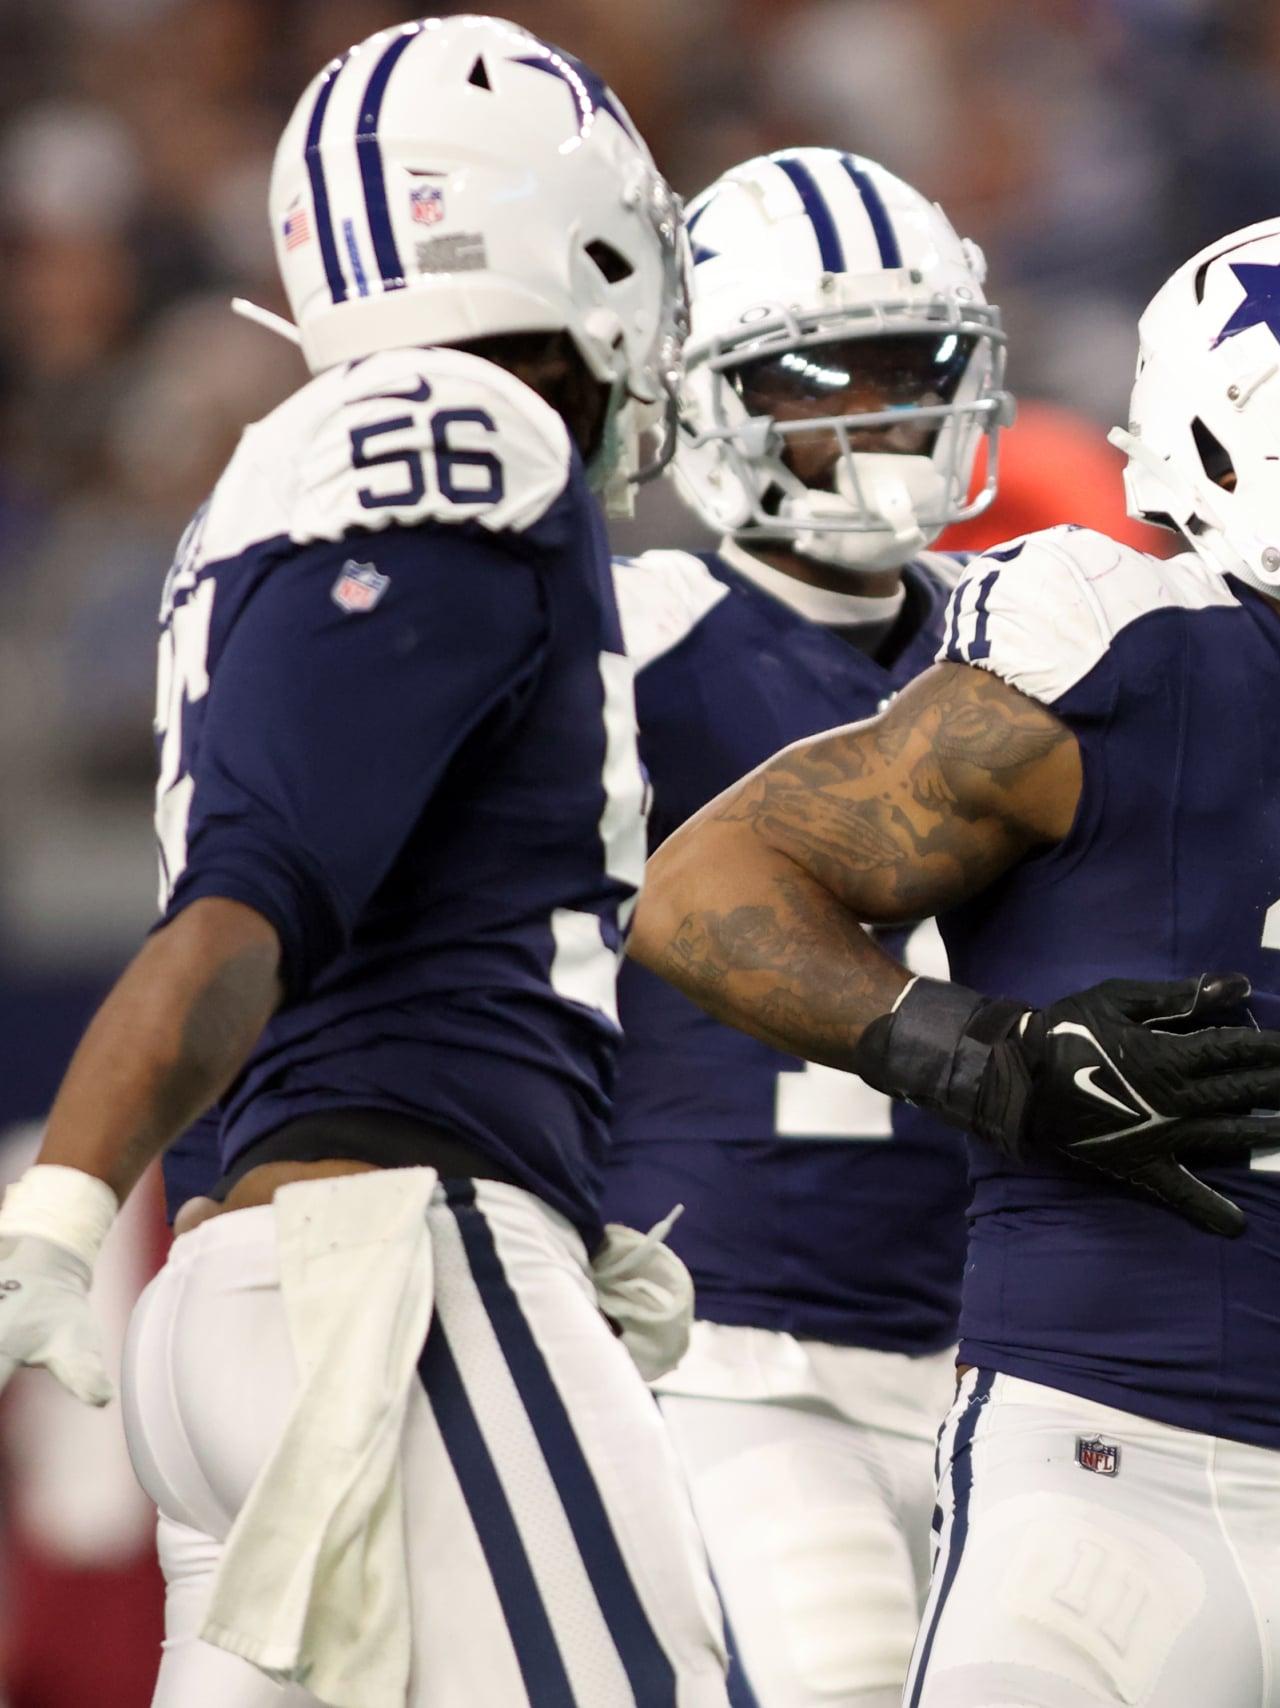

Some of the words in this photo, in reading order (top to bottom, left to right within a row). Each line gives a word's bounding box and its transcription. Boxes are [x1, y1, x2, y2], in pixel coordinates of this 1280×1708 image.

[350, 408, 504, 509] 56
[946, 570, 1000, 662] 11
[1083, 1450, 1113, 1471] NFL
